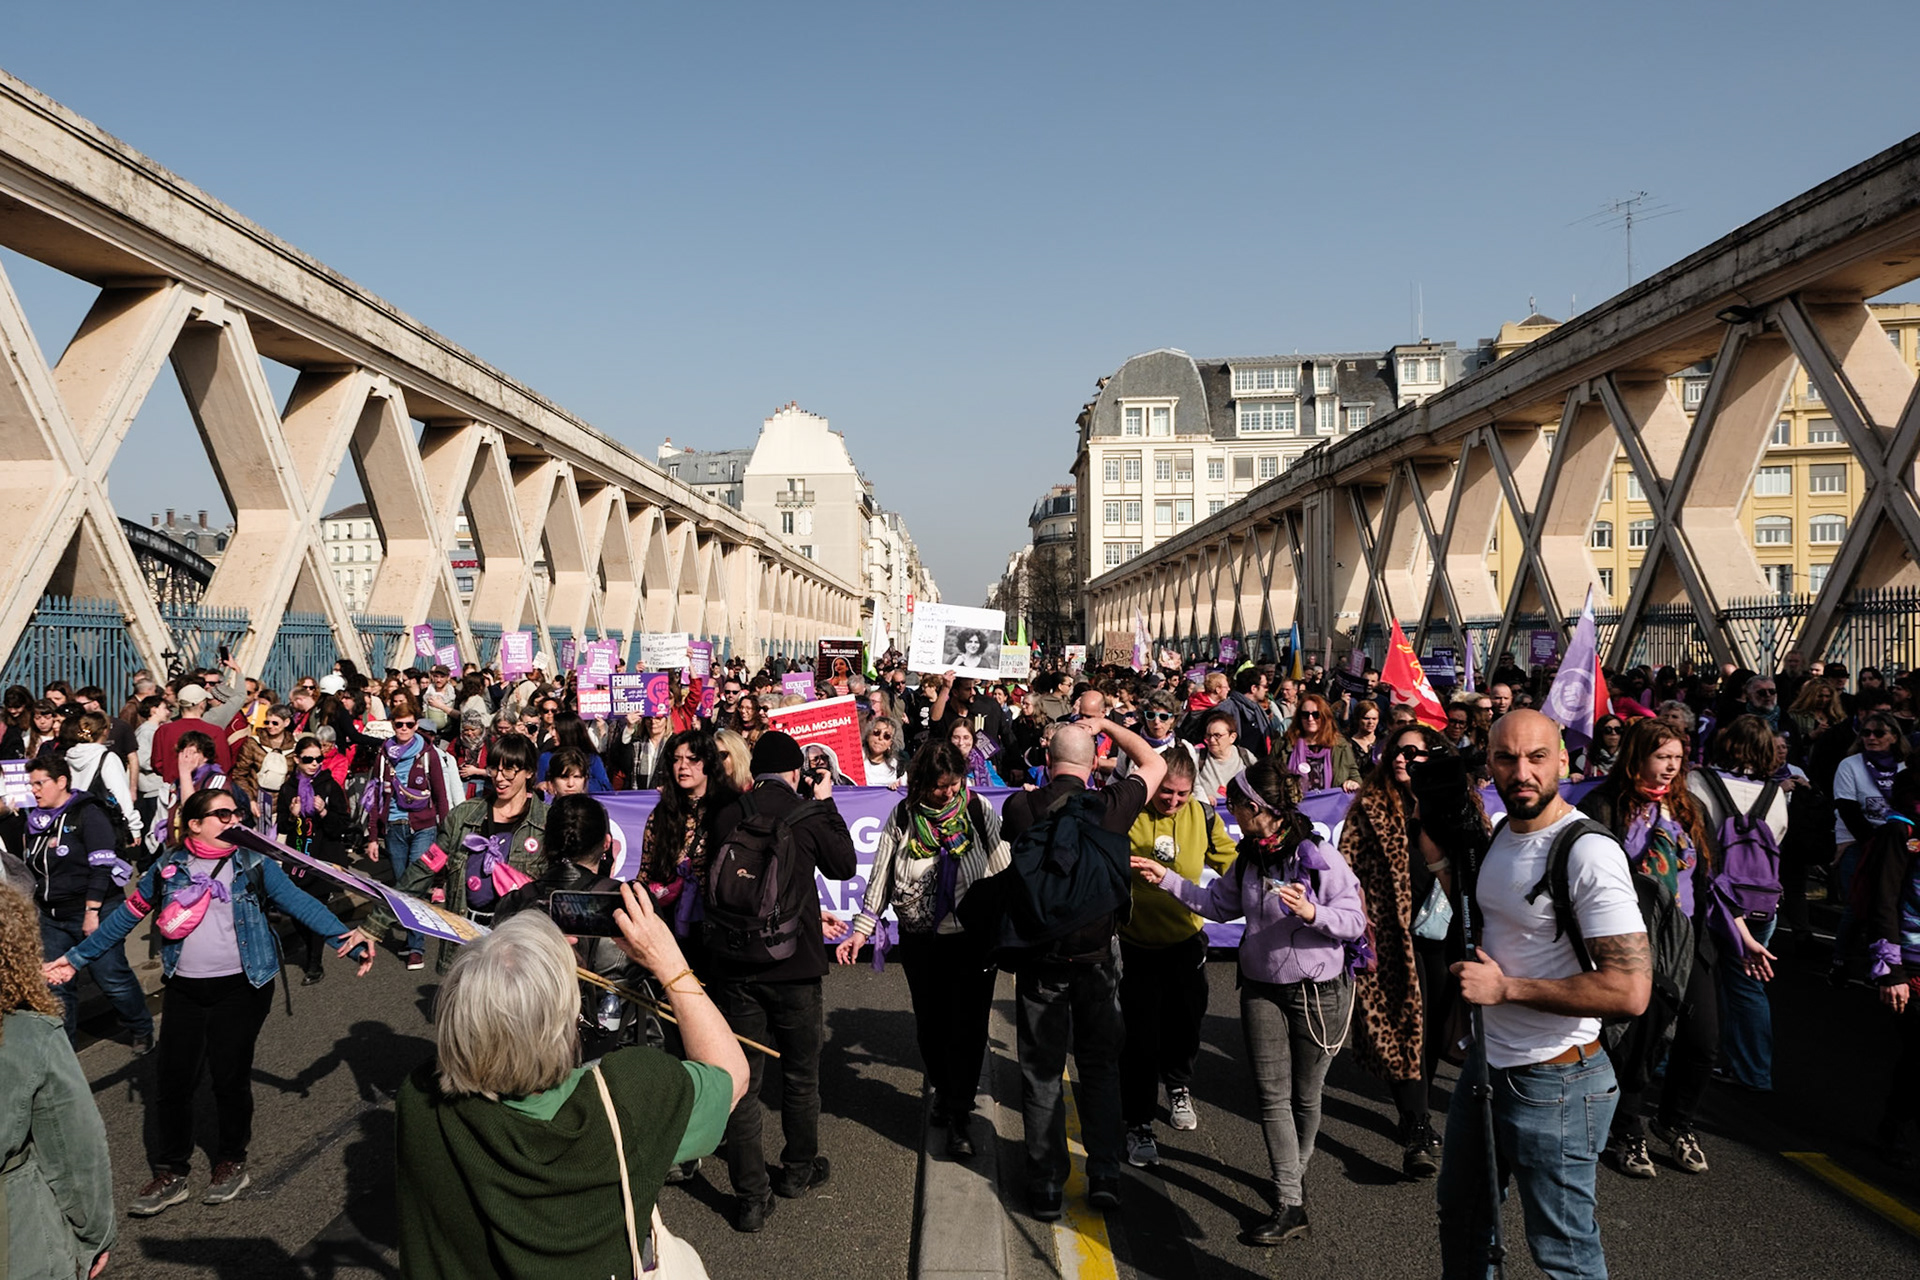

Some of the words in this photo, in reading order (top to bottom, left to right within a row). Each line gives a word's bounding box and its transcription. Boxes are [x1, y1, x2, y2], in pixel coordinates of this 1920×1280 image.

[612, 675, 644, 687] FEMME,
[580, 691, 610, 703] NÉMÉSI
[612, 688, 628, 701] VIE,
[613, 699, 645, 713] LIBERTÉ
[812, 716, 852, 731] MOSBAH
